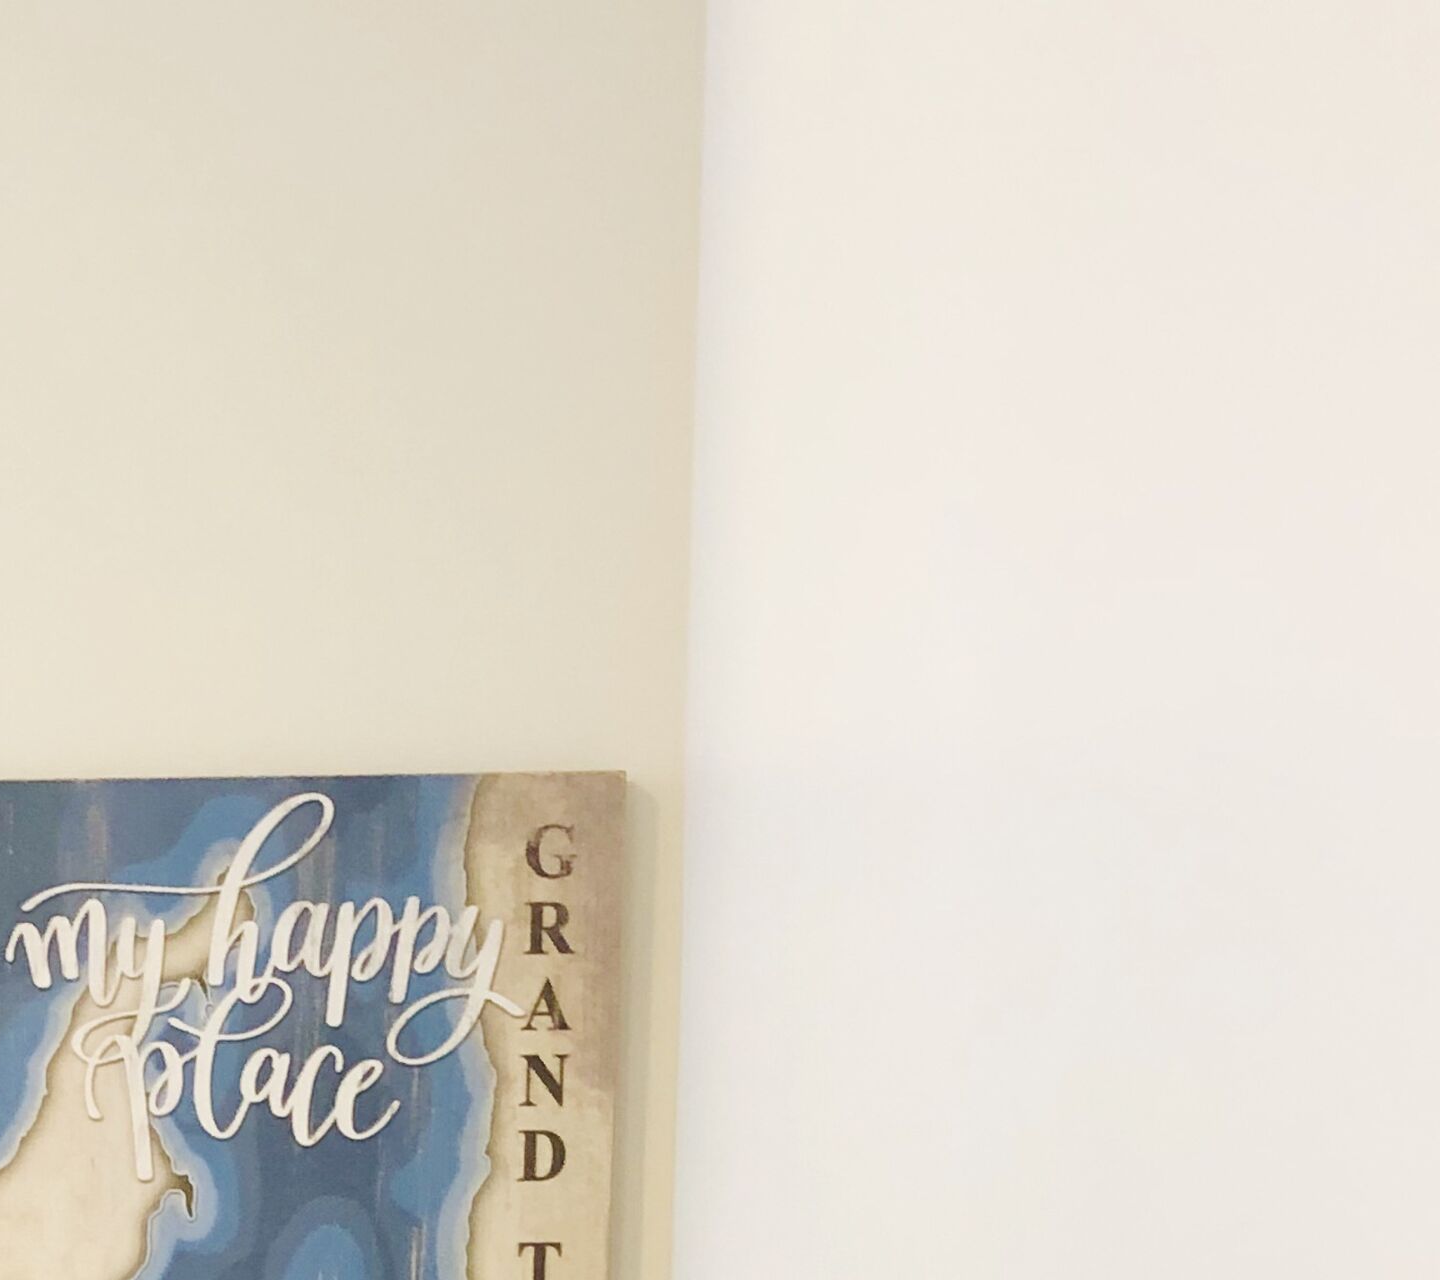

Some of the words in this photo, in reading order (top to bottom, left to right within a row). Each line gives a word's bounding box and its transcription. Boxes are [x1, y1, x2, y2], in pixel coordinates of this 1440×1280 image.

[5, 898, 192, 1066] my
[21, 791, 527, 1067] happy
[517, 823, 577, 1182] GRAND
[83, 976, 401, 1182] place
